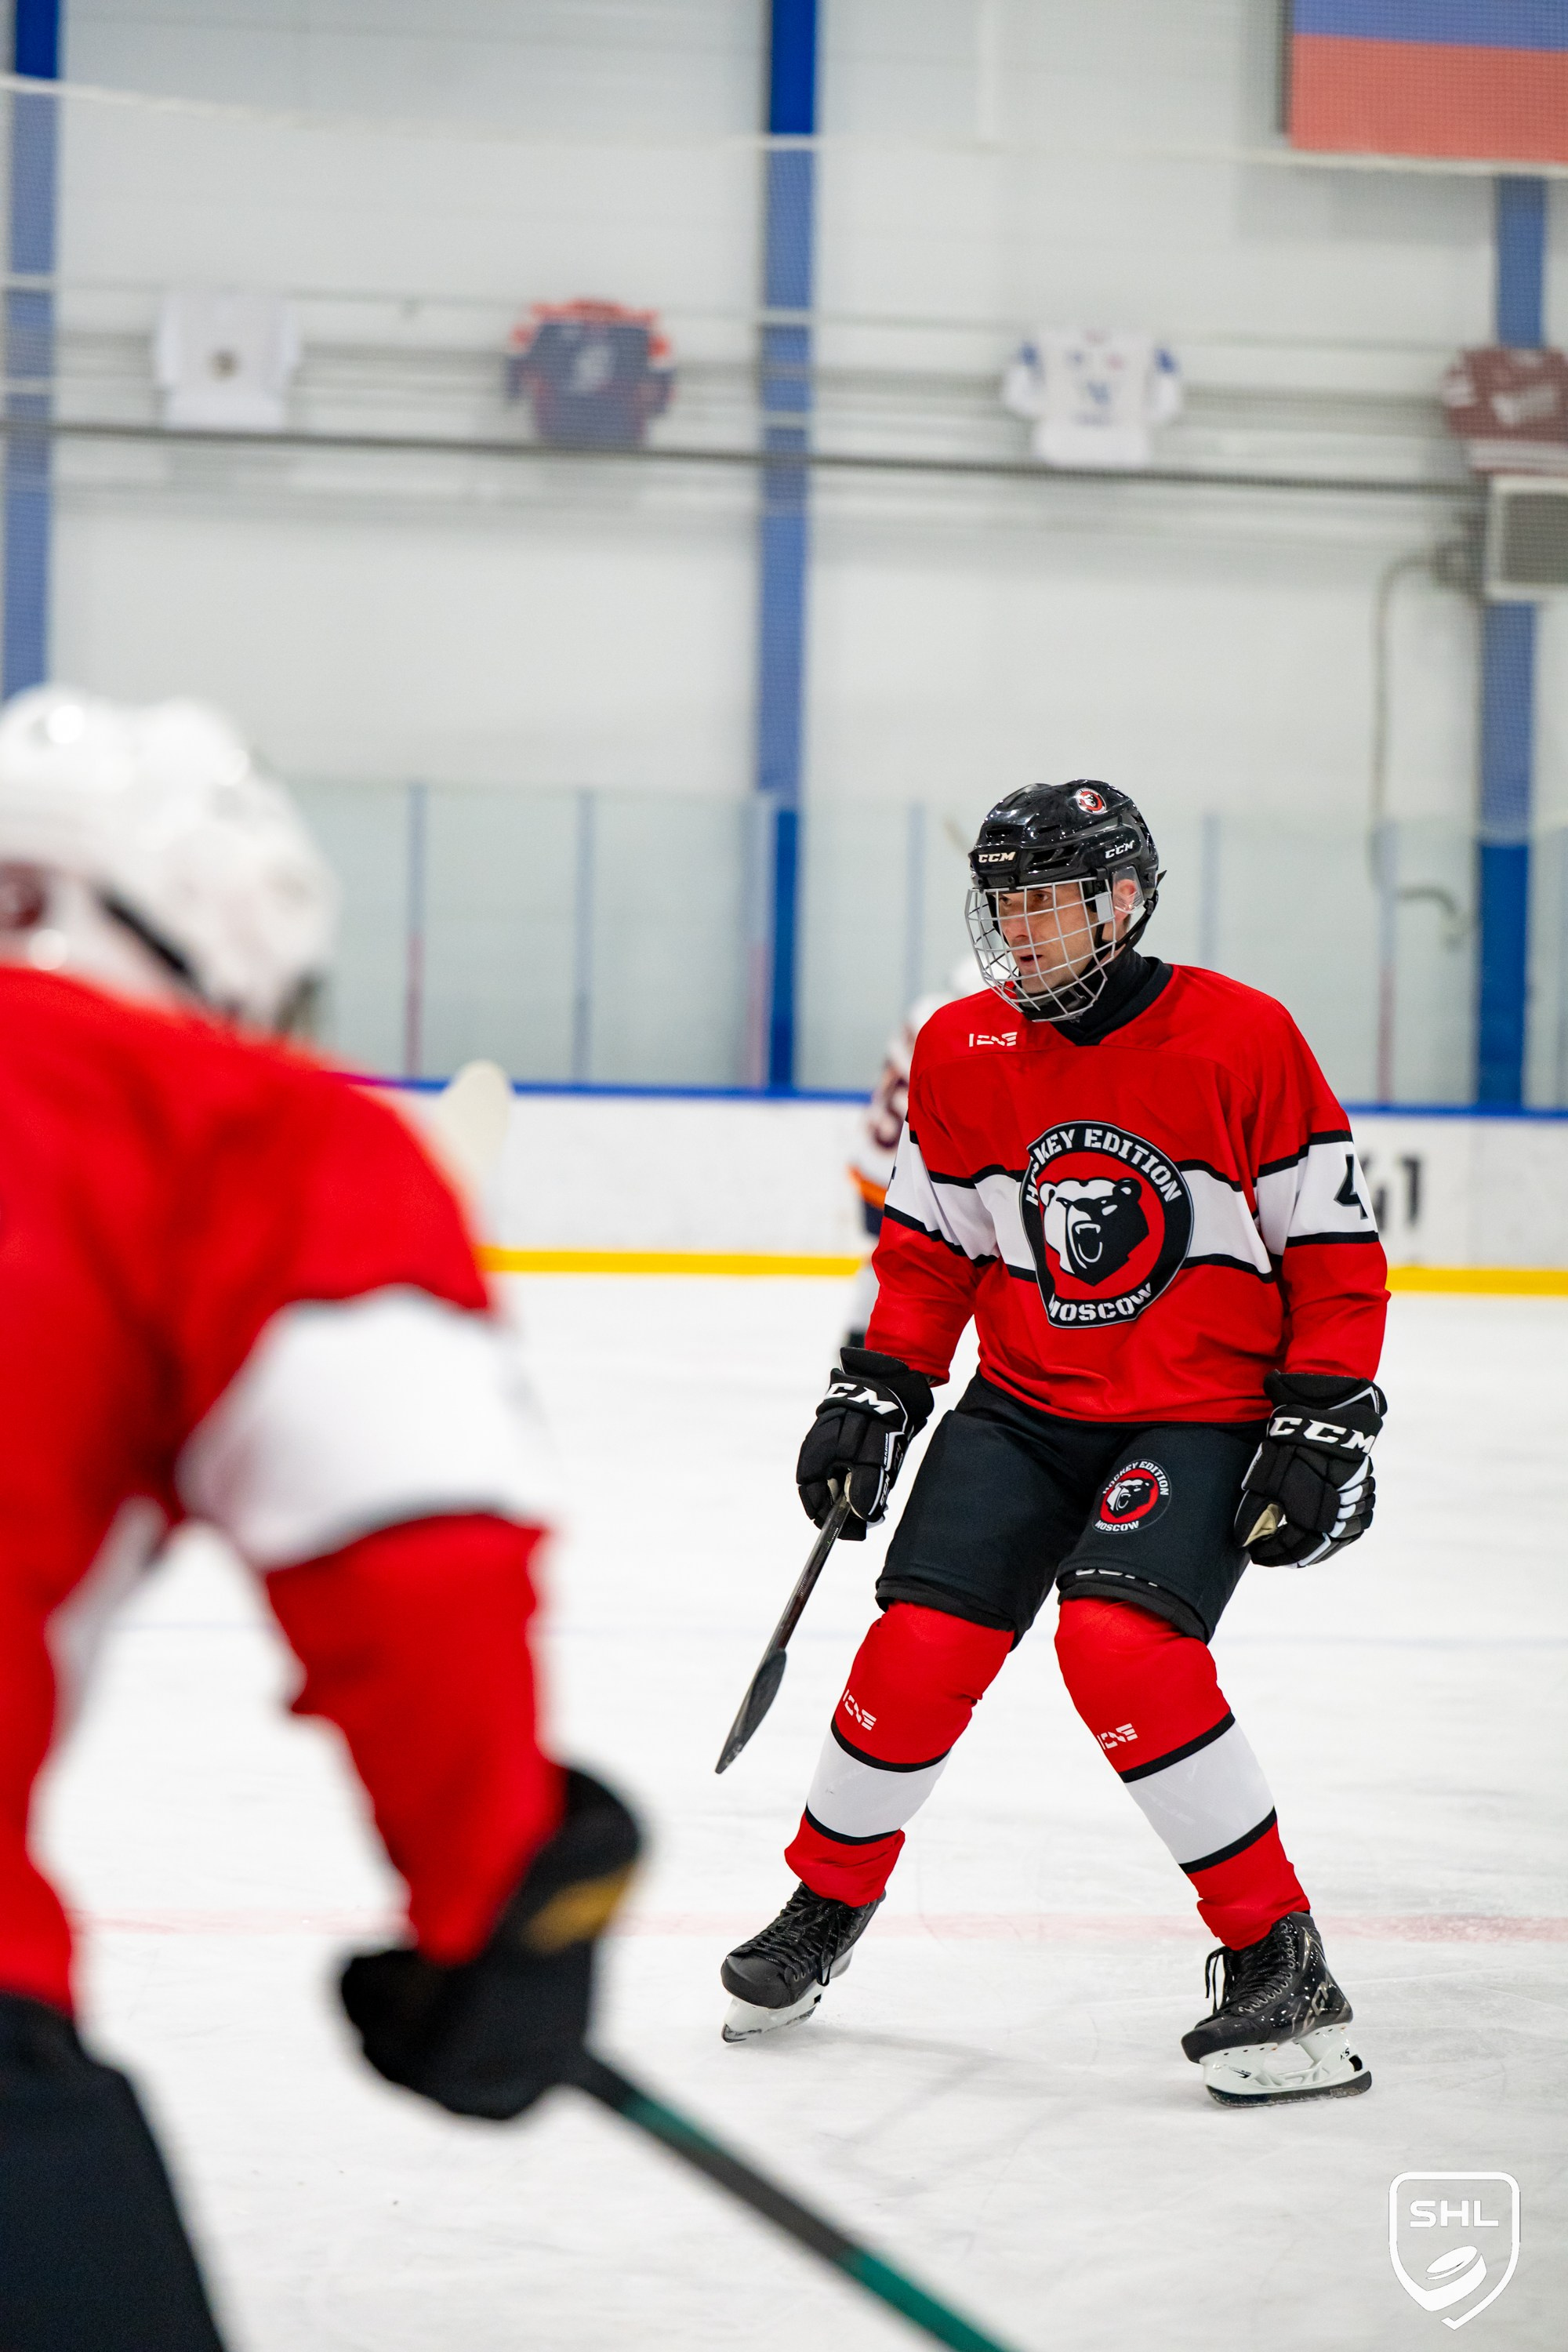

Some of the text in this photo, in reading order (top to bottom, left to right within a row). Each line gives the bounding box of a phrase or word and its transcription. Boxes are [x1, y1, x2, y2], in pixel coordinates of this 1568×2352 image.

[978, 851, 1017, 863] CCM
[1105, 840, 1135, 859] CCM
[1025, 1128, 1182, 1207] HKEY EDITION
[825, 1382, 900, 1415] CM
[1269, 1417, 1376, 1454] CCM
[1138, 1461, 1170, 1496] EDITION
[1094, 1519, 1140, 1532] MOSCOW
